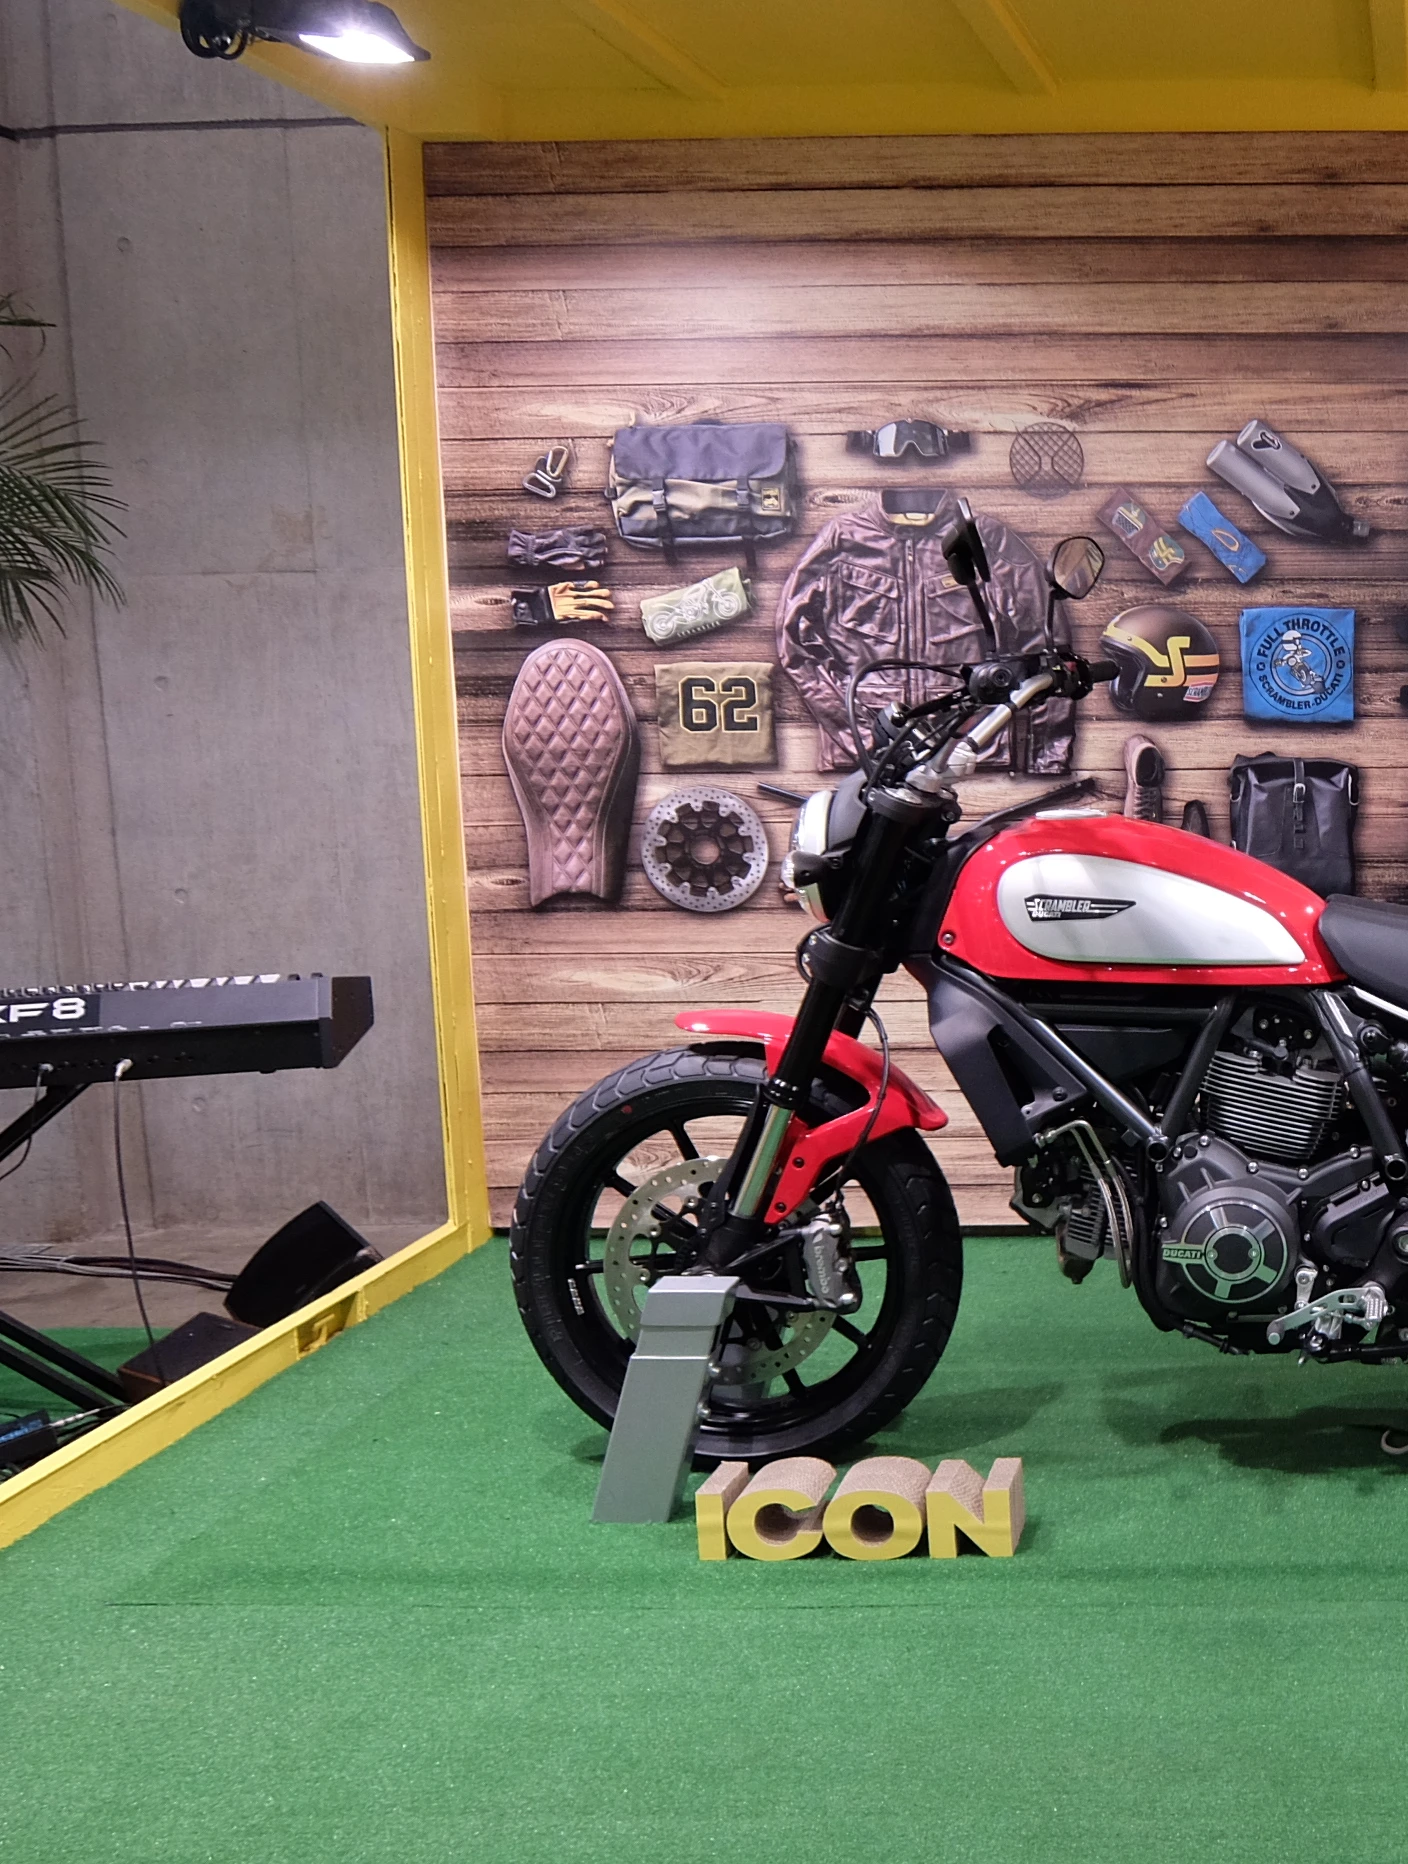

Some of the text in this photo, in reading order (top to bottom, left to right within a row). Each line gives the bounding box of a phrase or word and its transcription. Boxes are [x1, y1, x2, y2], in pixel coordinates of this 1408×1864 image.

[1257, 617, 1346, 659] FULL THROTTLE
[679, 675, 759, 733] 62
[1034, 898, 1092, 913] SCRAMBLER
[0, 997, 86, 1024] F8
[814, 1245, 831, 1294] brembo
[1162, 1248, 1202, 1259] DUCATI
[695, 1472, 1018, 1561] ICON
